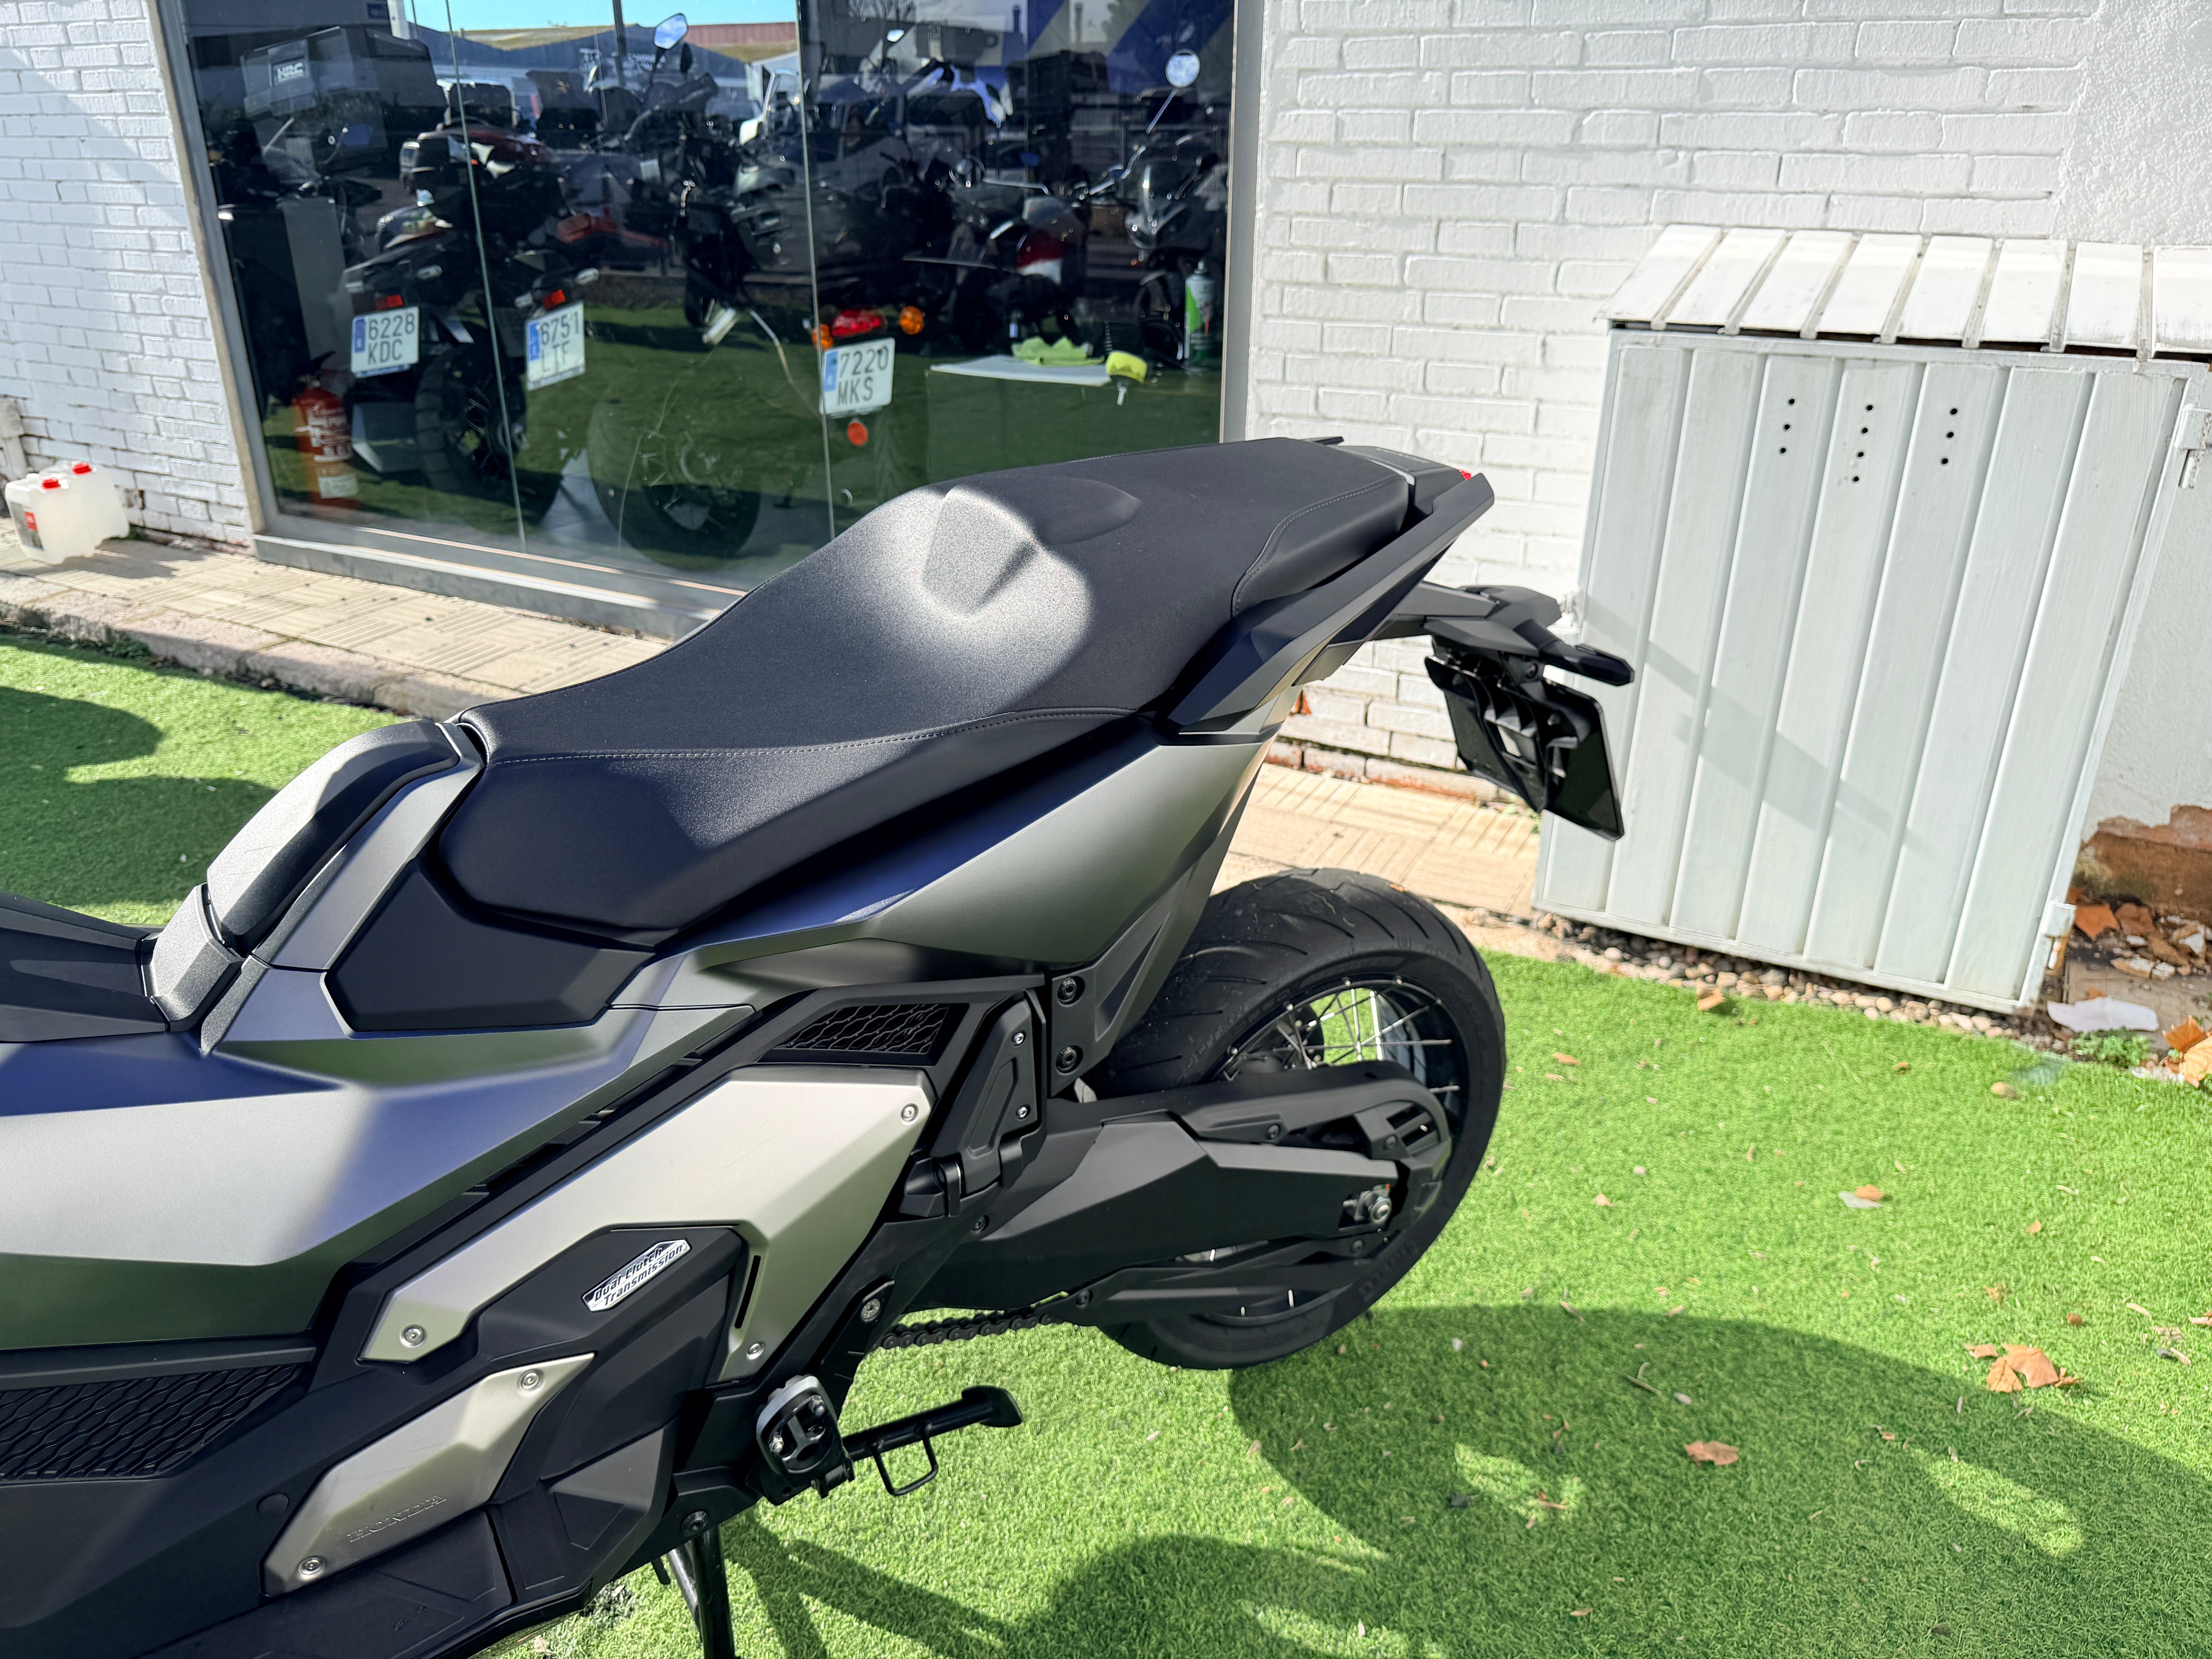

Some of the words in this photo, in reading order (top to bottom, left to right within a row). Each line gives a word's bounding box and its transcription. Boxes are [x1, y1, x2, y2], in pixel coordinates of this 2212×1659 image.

[369, 313, 415, 340] 6228
[541, 311, 579, 345] 6751
[368, 338, 403, 364] KDC
[542, 339, 570, 373] LTF
[840, 345, 889, 378] 7220
[838, 376, 873, 406] MKS
[594, 1274, 622, 1302] Dual
[625, 1247, 662, 1279] Clutch
[604, 1244, 684, 1306] Transmission
[347, 1496, 447, 1542] HONDA
